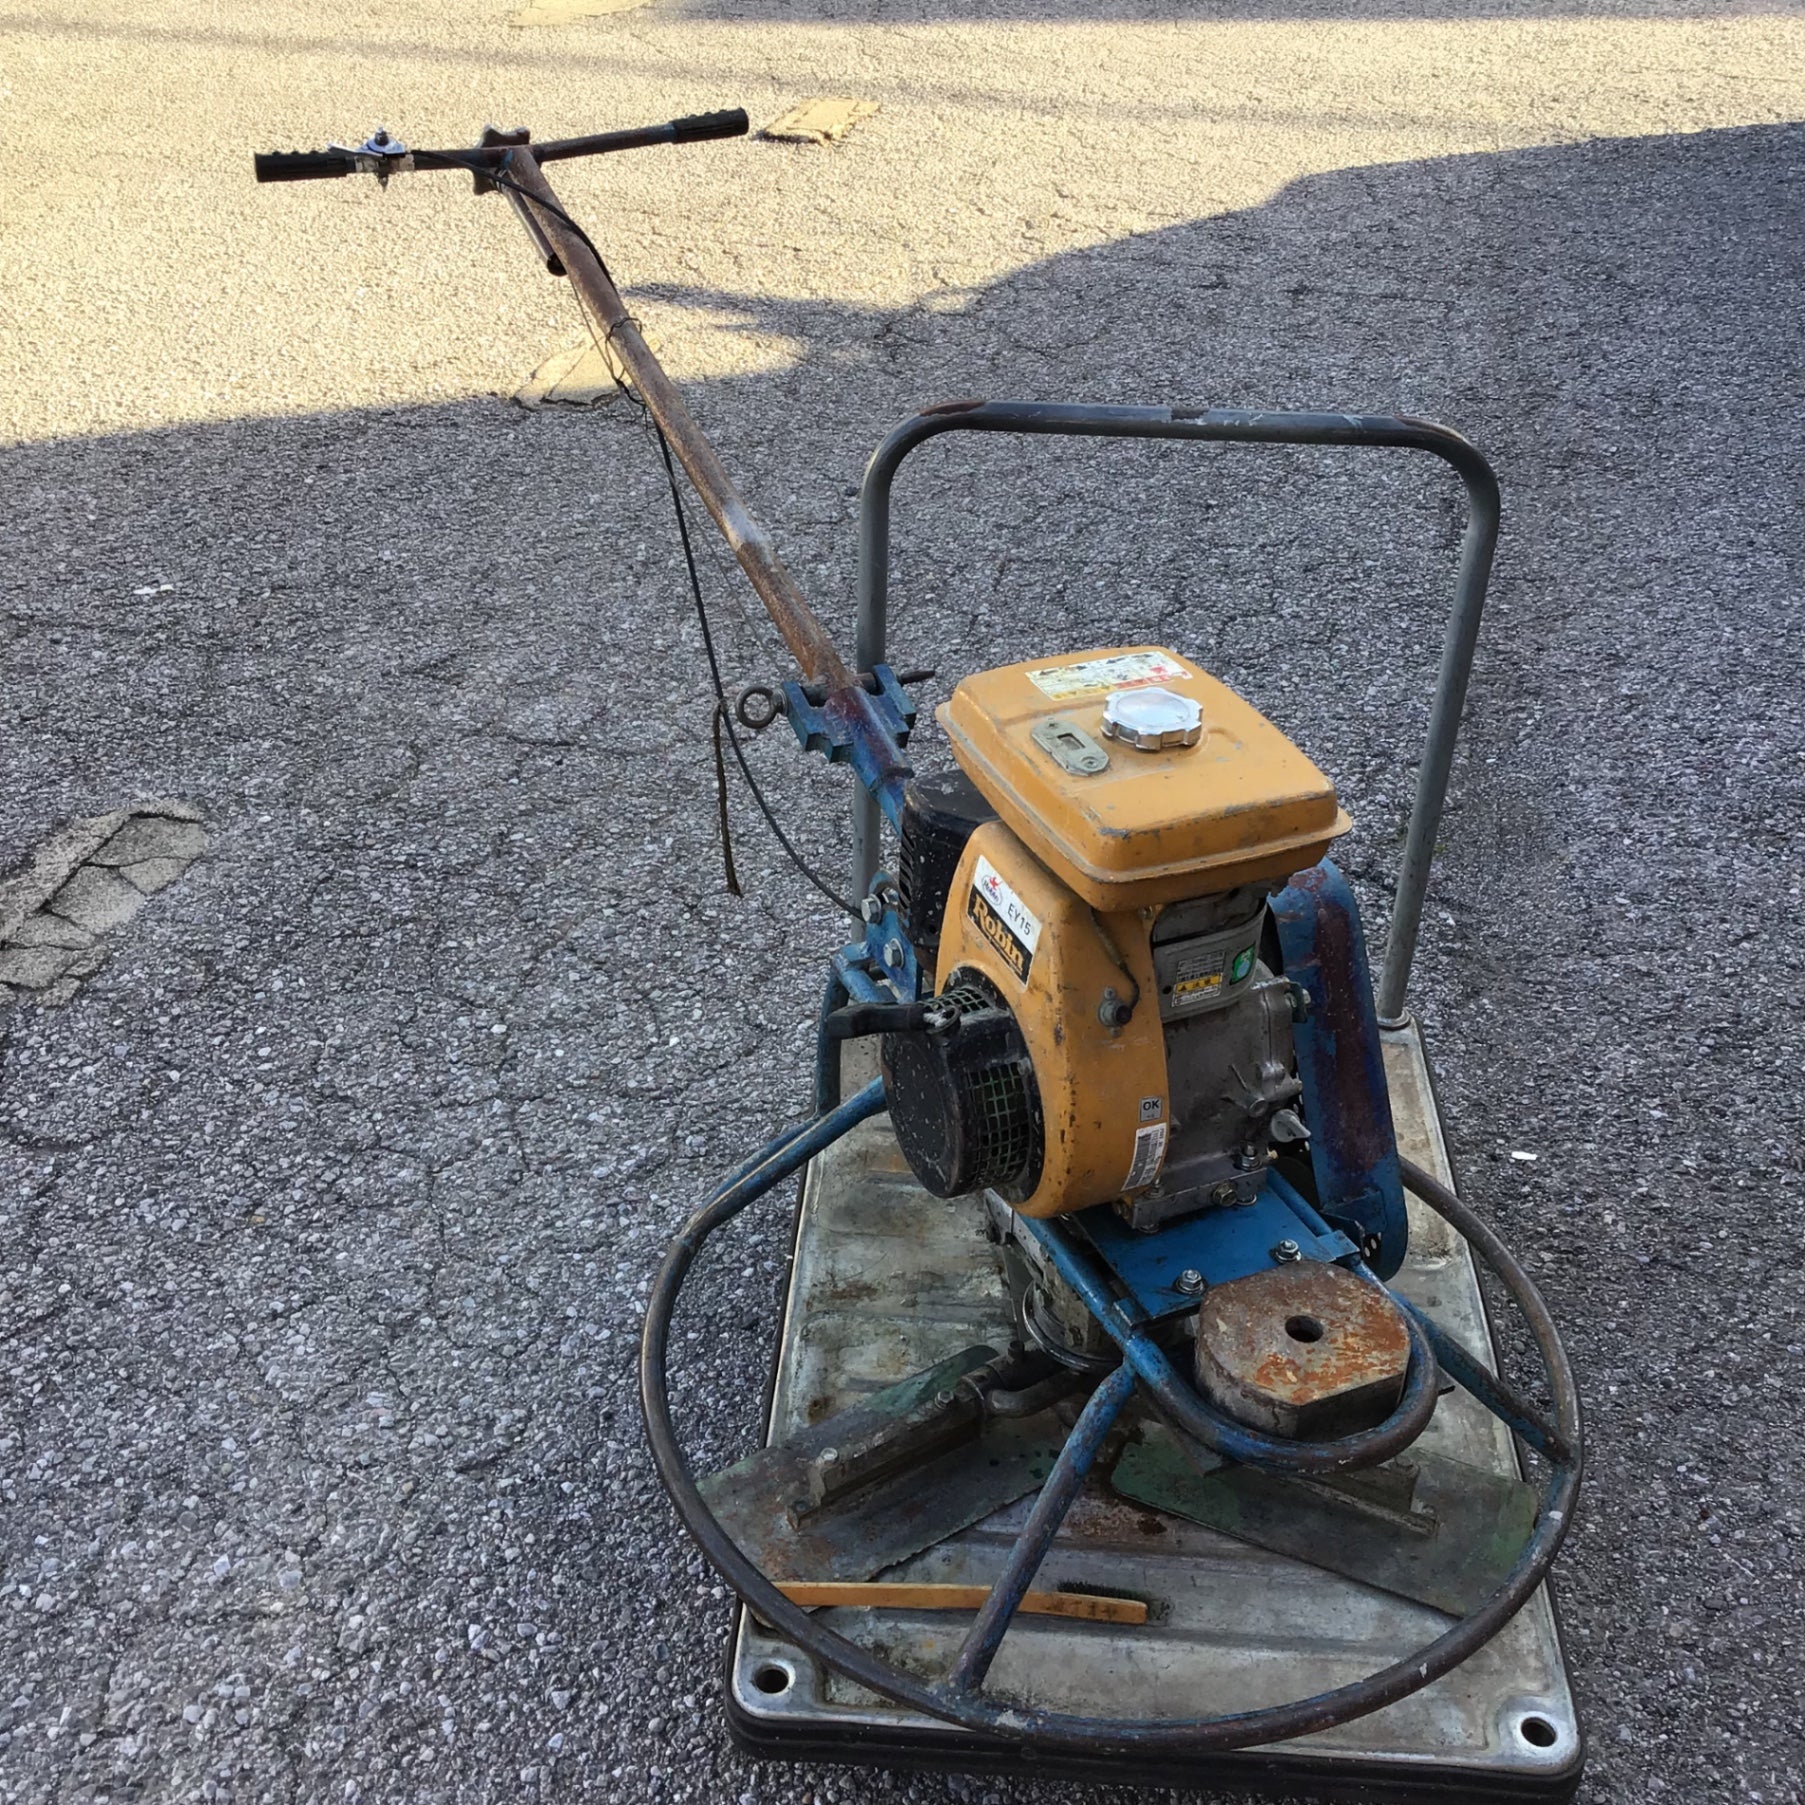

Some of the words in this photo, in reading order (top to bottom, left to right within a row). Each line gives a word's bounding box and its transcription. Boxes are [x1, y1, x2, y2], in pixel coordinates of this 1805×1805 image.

[973, 894, 1024, 973] Robin
[1007, 903, 1031, 935] EY15
[1143, 1100, 1159, 1111] OK
